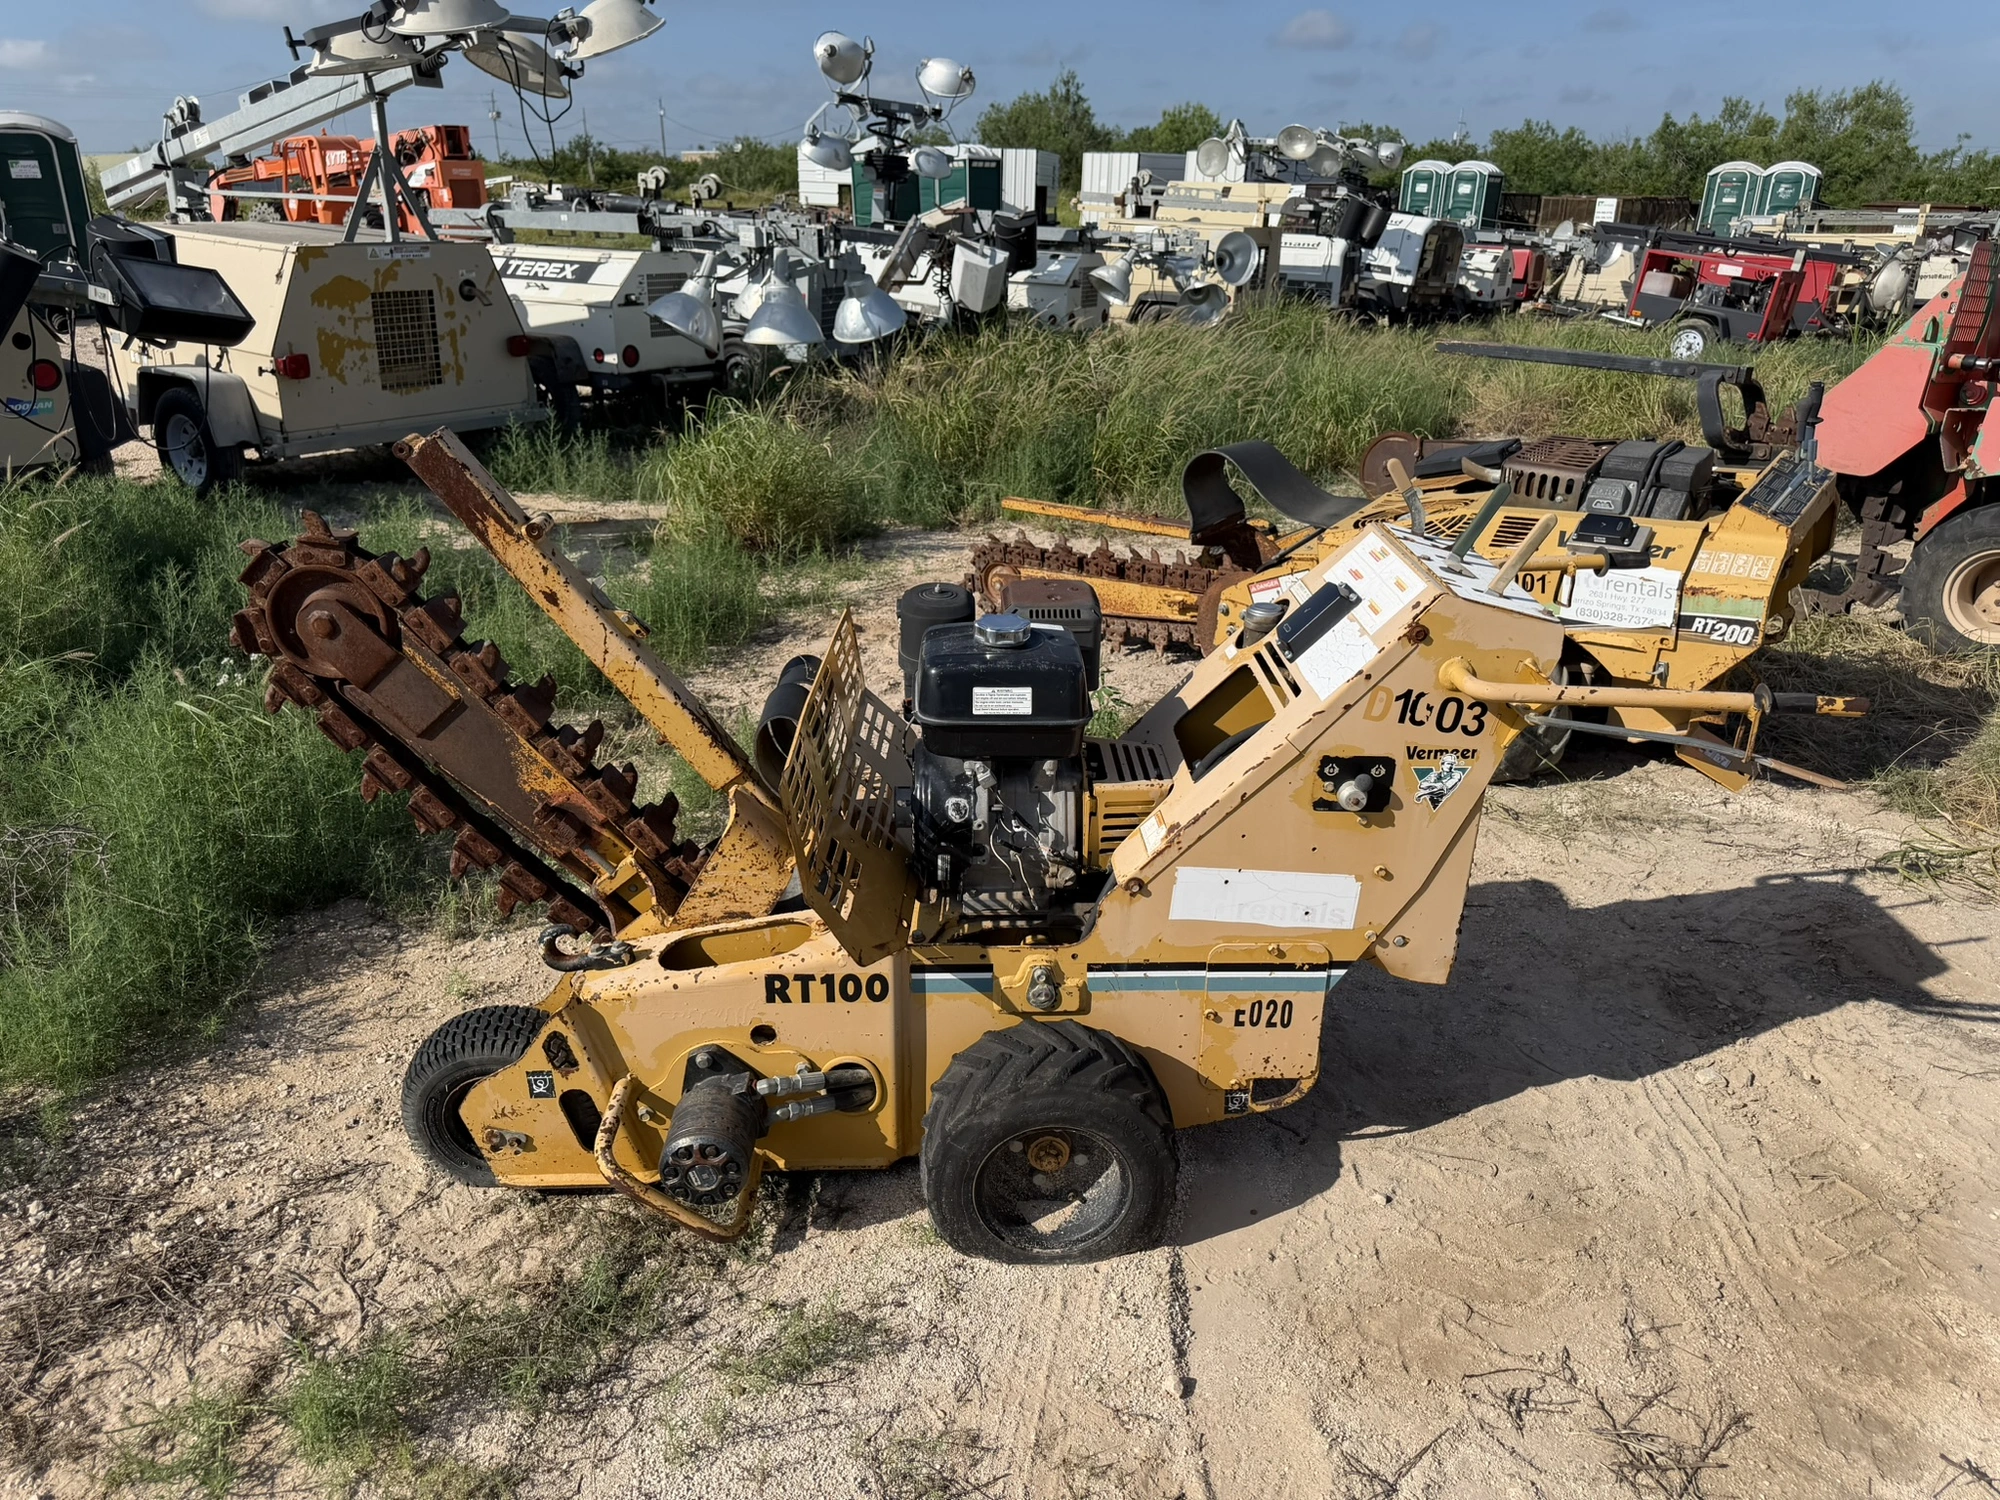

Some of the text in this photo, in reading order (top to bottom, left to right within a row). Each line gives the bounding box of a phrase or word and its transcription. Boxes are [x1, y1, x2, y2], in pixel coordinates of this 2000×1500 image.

[506, 259, 580, 279] TEREX
[1606, 579, 1673, 600] rentals
[1573, 597, 1595, 606] arrizo
[1630, 596, 1646, 604] 277
[1691, 617, 1755, 645] RT200
[1406, 745, 1478, 760] Vermeer
[764, 973, 890, 1003] RT100
